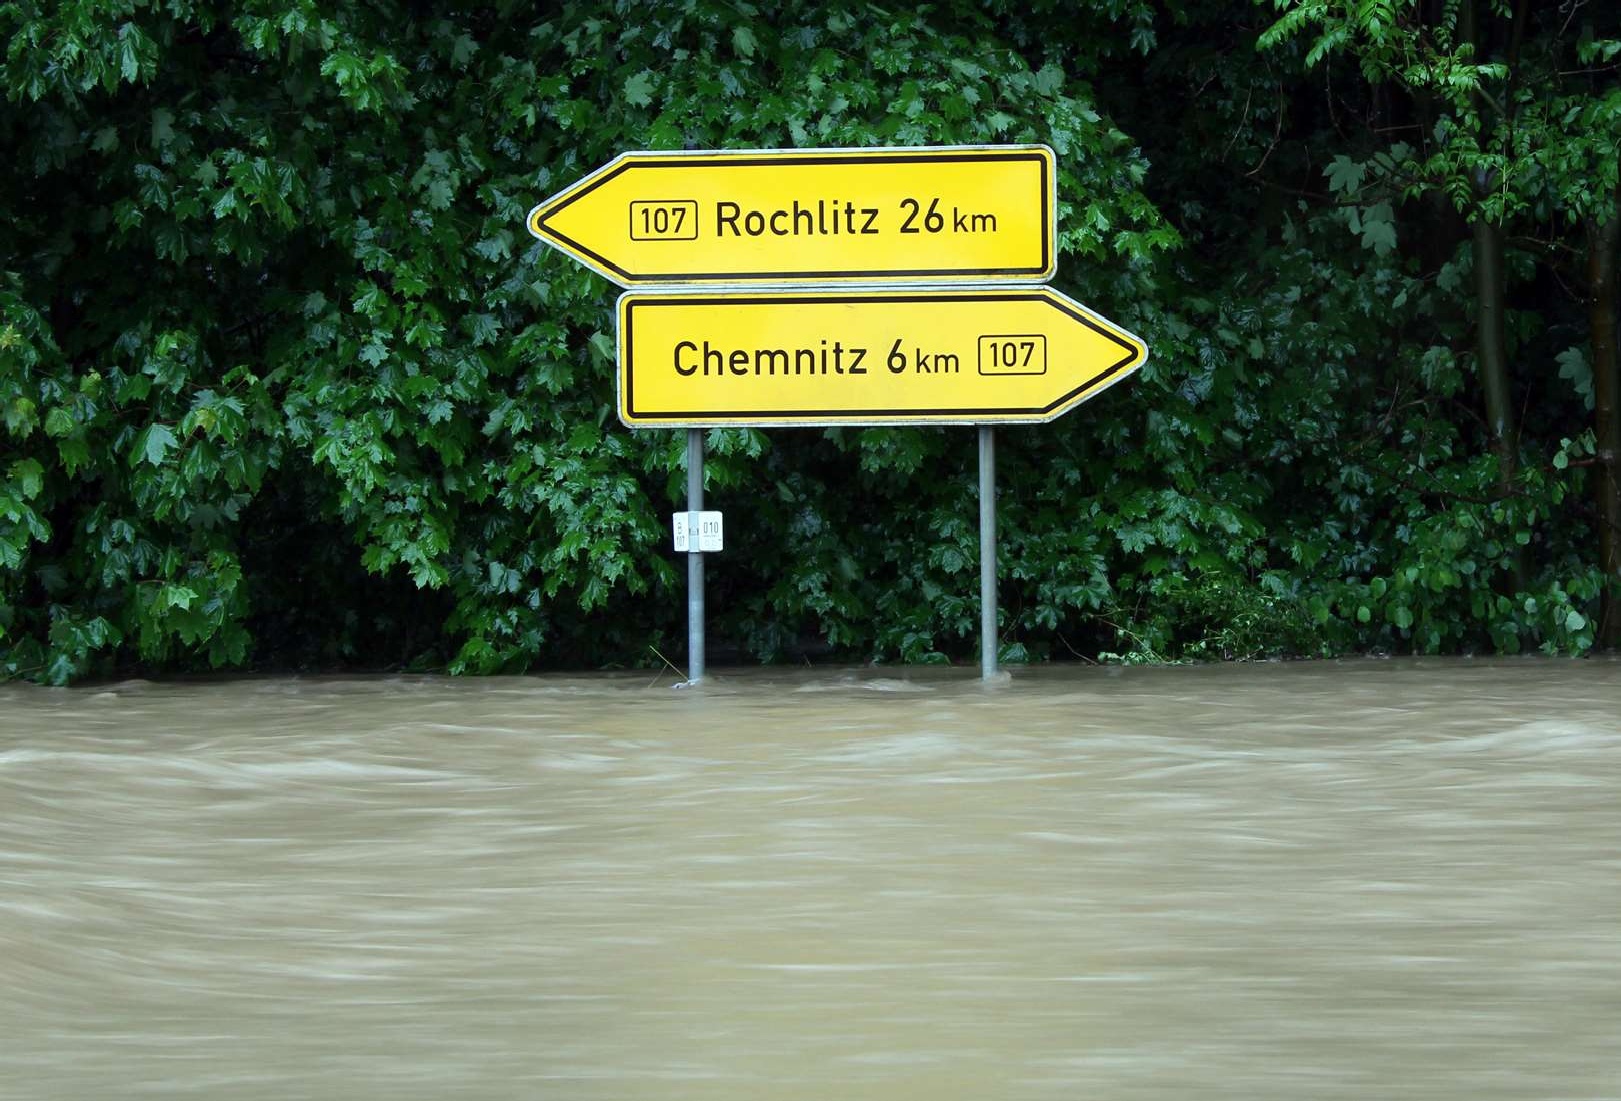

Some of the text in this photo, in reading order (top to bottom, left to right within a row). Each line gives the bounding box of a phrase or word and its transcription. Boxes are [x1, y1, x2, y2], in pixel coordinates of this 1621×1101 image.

[641, 198, 997, 237] 107 Rochlitz 26 km
[674, 338, 1035, 377] Chemnitz 6 km 107
[703, 521, 719, 534] 010
